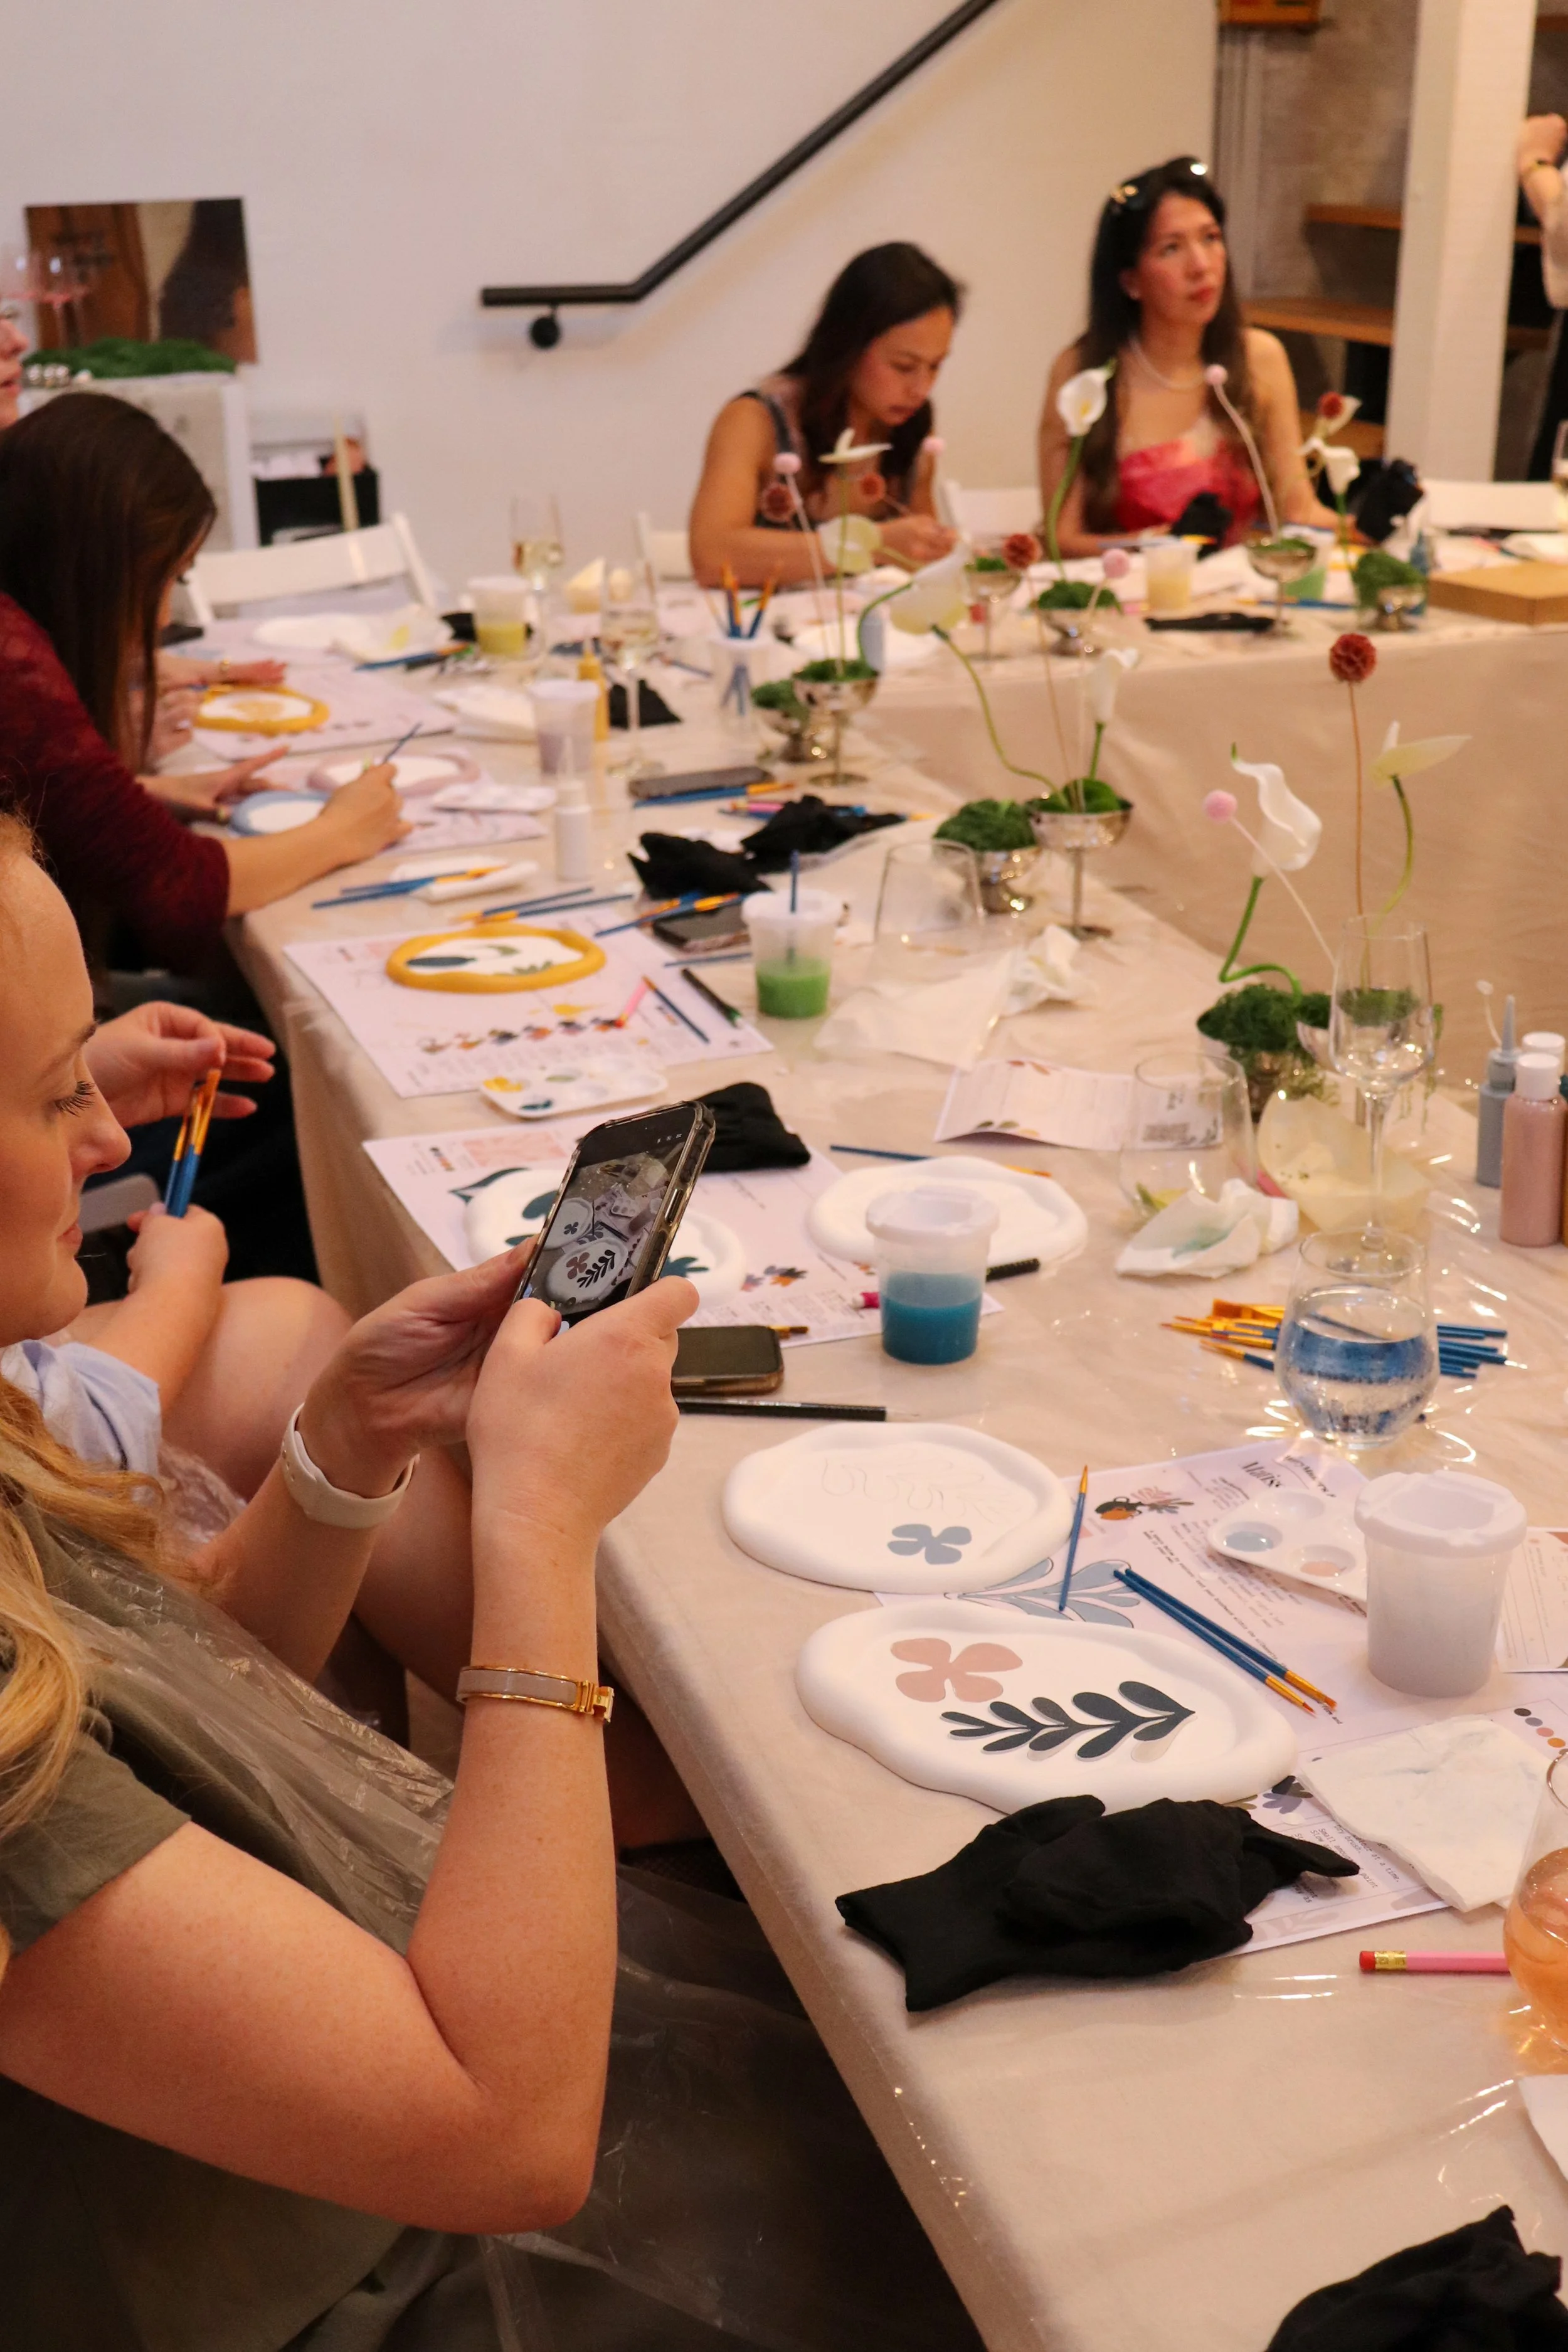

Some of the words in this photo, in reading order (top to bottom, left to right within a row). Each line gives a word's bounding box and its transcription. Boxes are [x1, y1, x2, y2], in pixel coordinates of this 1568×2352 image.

[1310, 1830, 1323, 1842] Slow
[1318, 1828, 1336, 1843] Small
[1359, 1873, 1378, 1888] paint
[1385, 1867, 1400, 1882] time.
